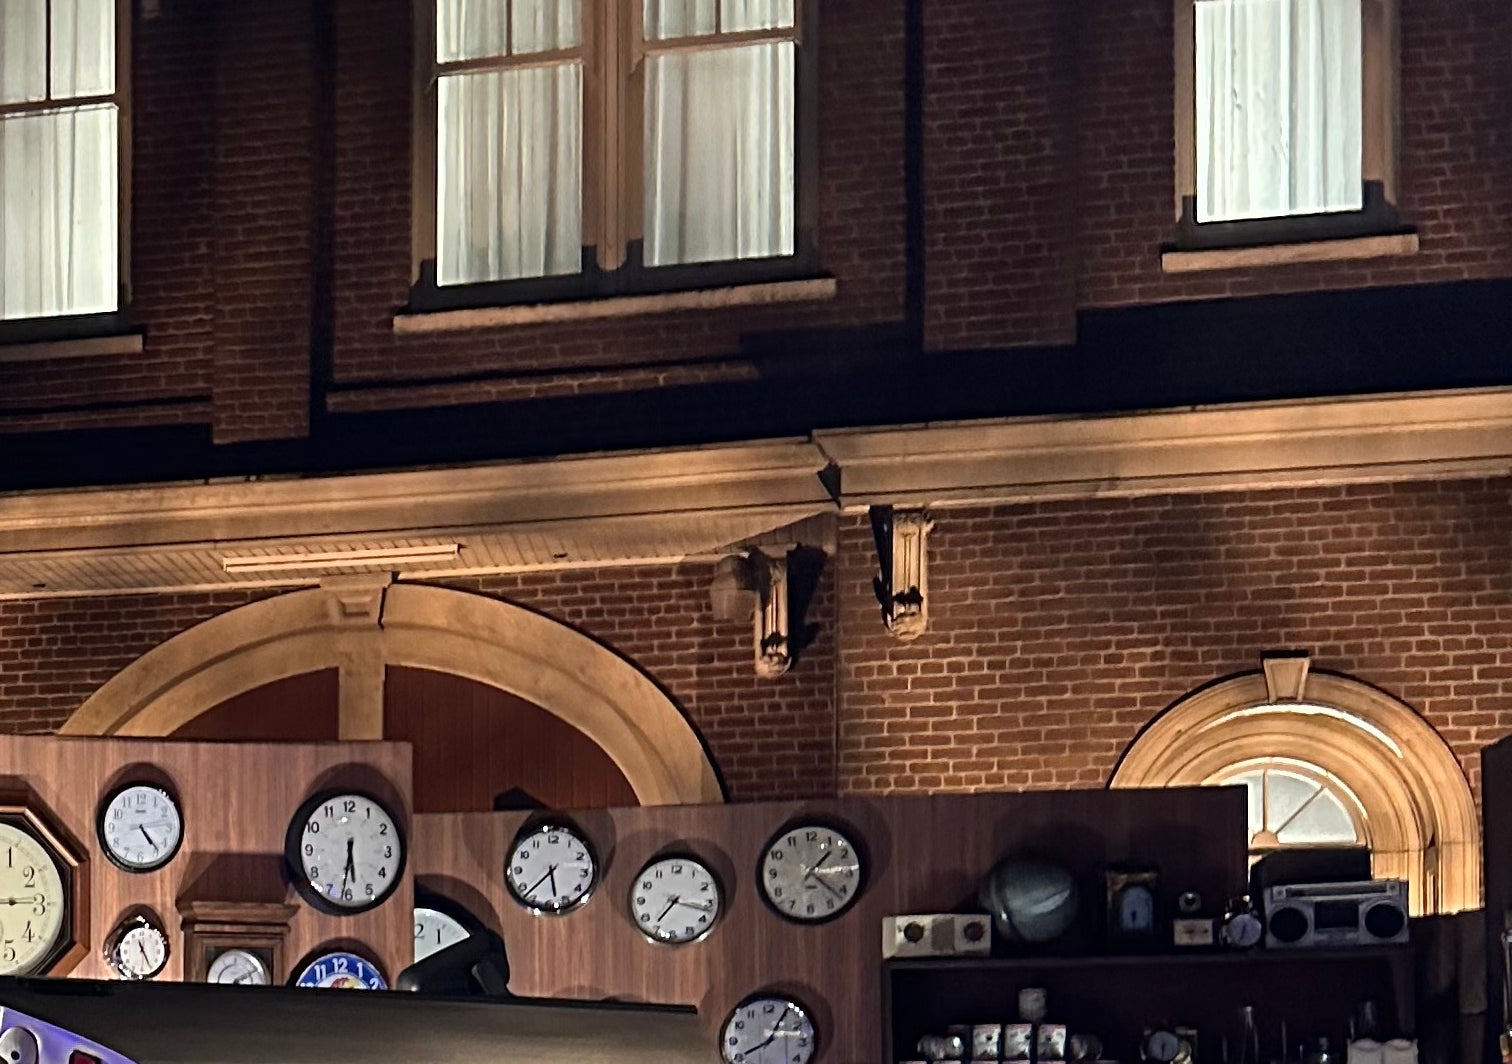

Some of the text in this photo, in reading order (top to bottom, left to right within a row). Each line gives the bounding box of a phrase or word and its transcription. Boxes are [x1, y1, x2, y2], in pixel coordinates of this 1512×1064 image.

[324, 805, 333, 818] 11
[343, 800, 356, 813] 12
[307, 821, 320, 834] 10
[379, 823, 387, 835] 2
[547, 835, 559, 844] 12
[788, 836, 796, 847] 11
[806, 831, 817, 842] 12
[305, 843, 313, 856] 9
[533, 839, 540, 848] 11
[384, 845, 392, 858] 3
[520, 850, 529, 859] 10
[576, 852, 585, 861] 2
[771, 850, 783, 861] 10
[840, 848, 848, 859] 2
[310, 866, 319, 878] 8
[377, 866, 386, 879] 4
[580, 868, 588, 878] 3
[655, 870, 663, 879] 11
[671, 865, 683, 874] 12
[769, 868, 777, 879] 9
[22, 866, 35, 888] 2
[326, 883, 333, 896] 7
[365, 883, 373, 896] 5
[642, 881, 652, 890] 10
[700, 882, 709, 891] 2
[344, 887, 353, 901] 6
[32, 893, 46, 916] 3
[21, 920, 35, 943] 4
[3, 940, 16, 962] 5
[332, 957, 348, 973] 12
[356, 962, 363, 978] 1
[314, 964, 326, 981] 11
